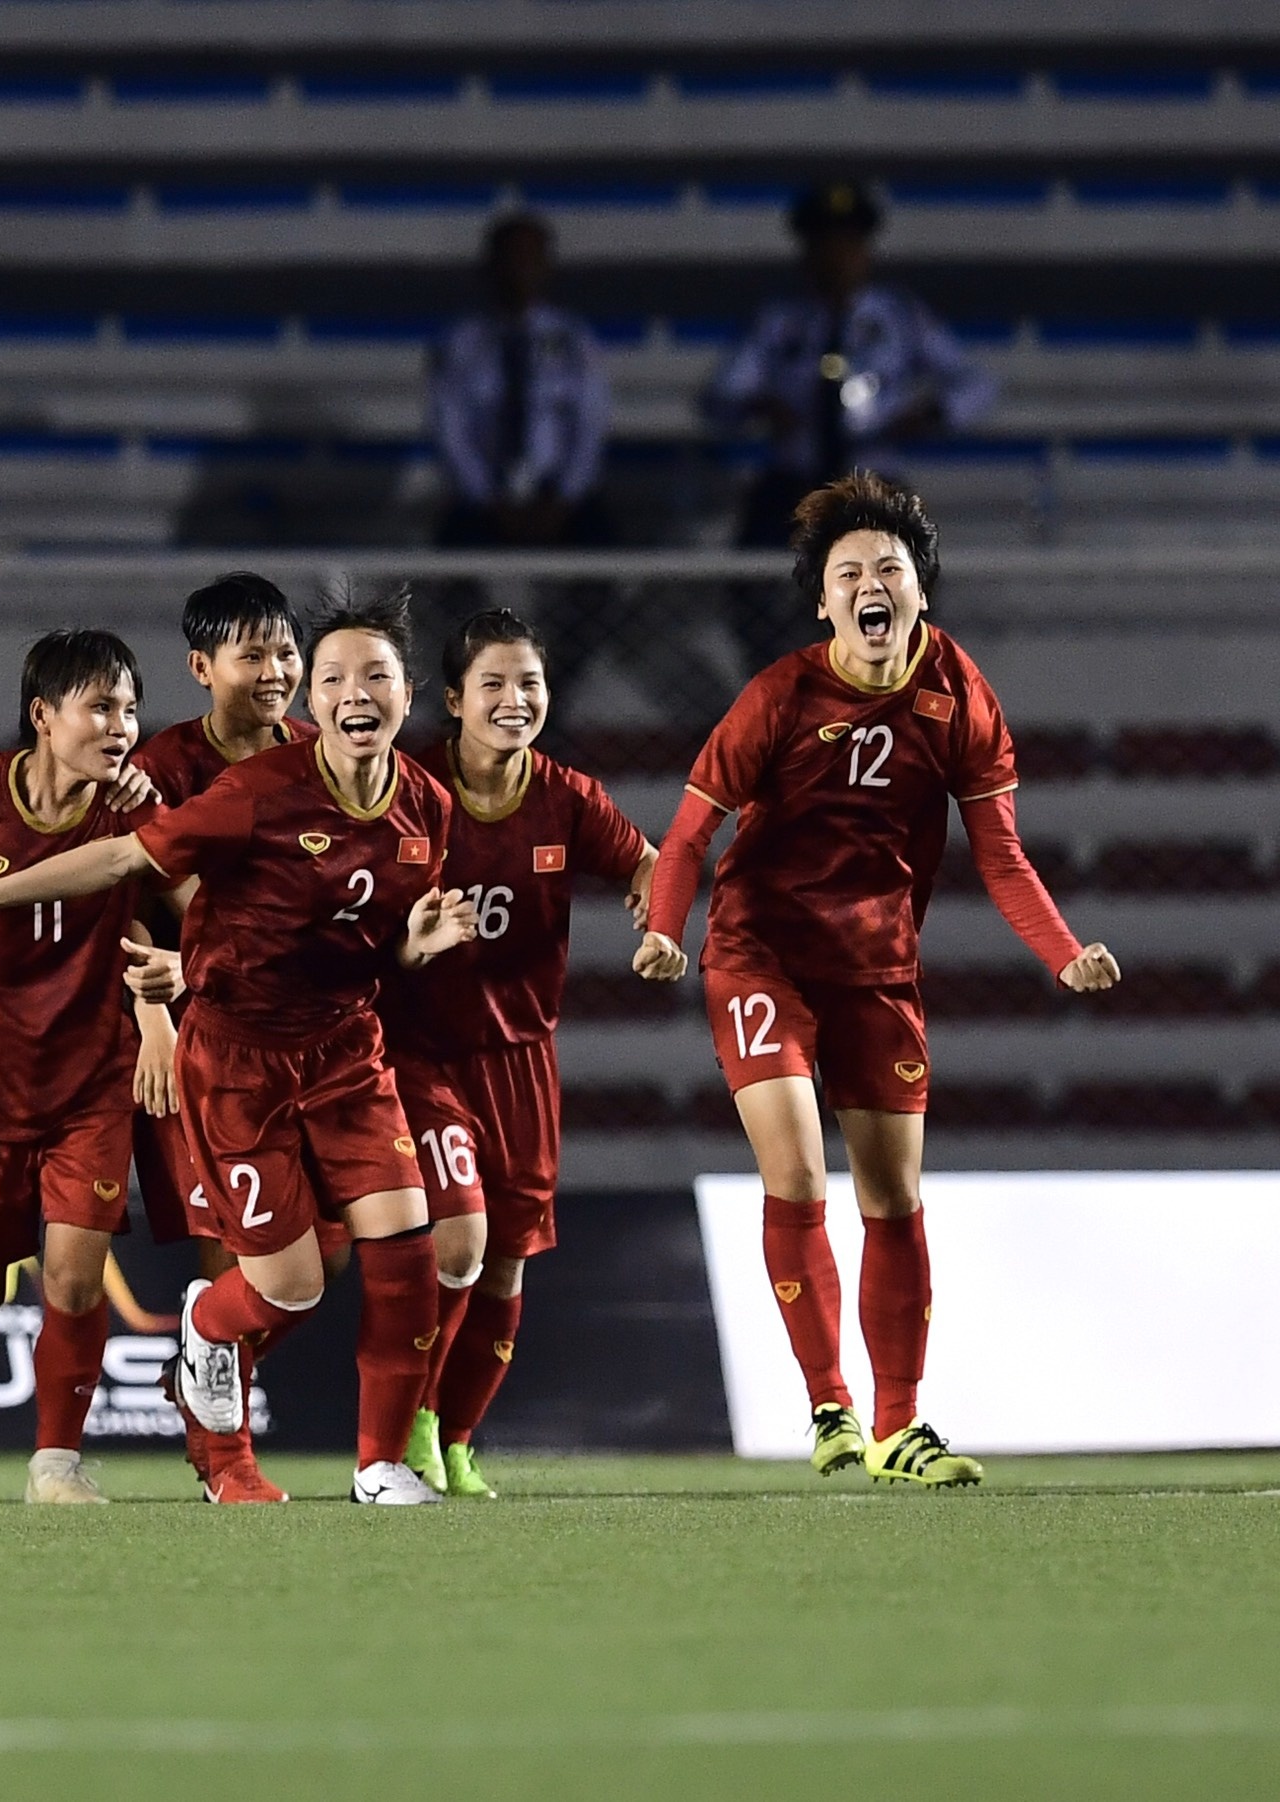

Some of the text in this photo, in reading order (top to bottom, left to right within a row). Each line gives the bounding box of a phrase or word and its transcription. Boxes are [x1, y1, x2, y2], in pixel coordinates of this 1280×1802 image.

[848, 725, 893, 787] 12
[34, 900, 62, 943] 11
[332, 868, 374, 921] 2
[467, 884, 514, 939] 16
[727, 992, 782, 1060] 12
[421, 1124, 475, 1191] 16
[230, 1163, 273, 1229] 2
